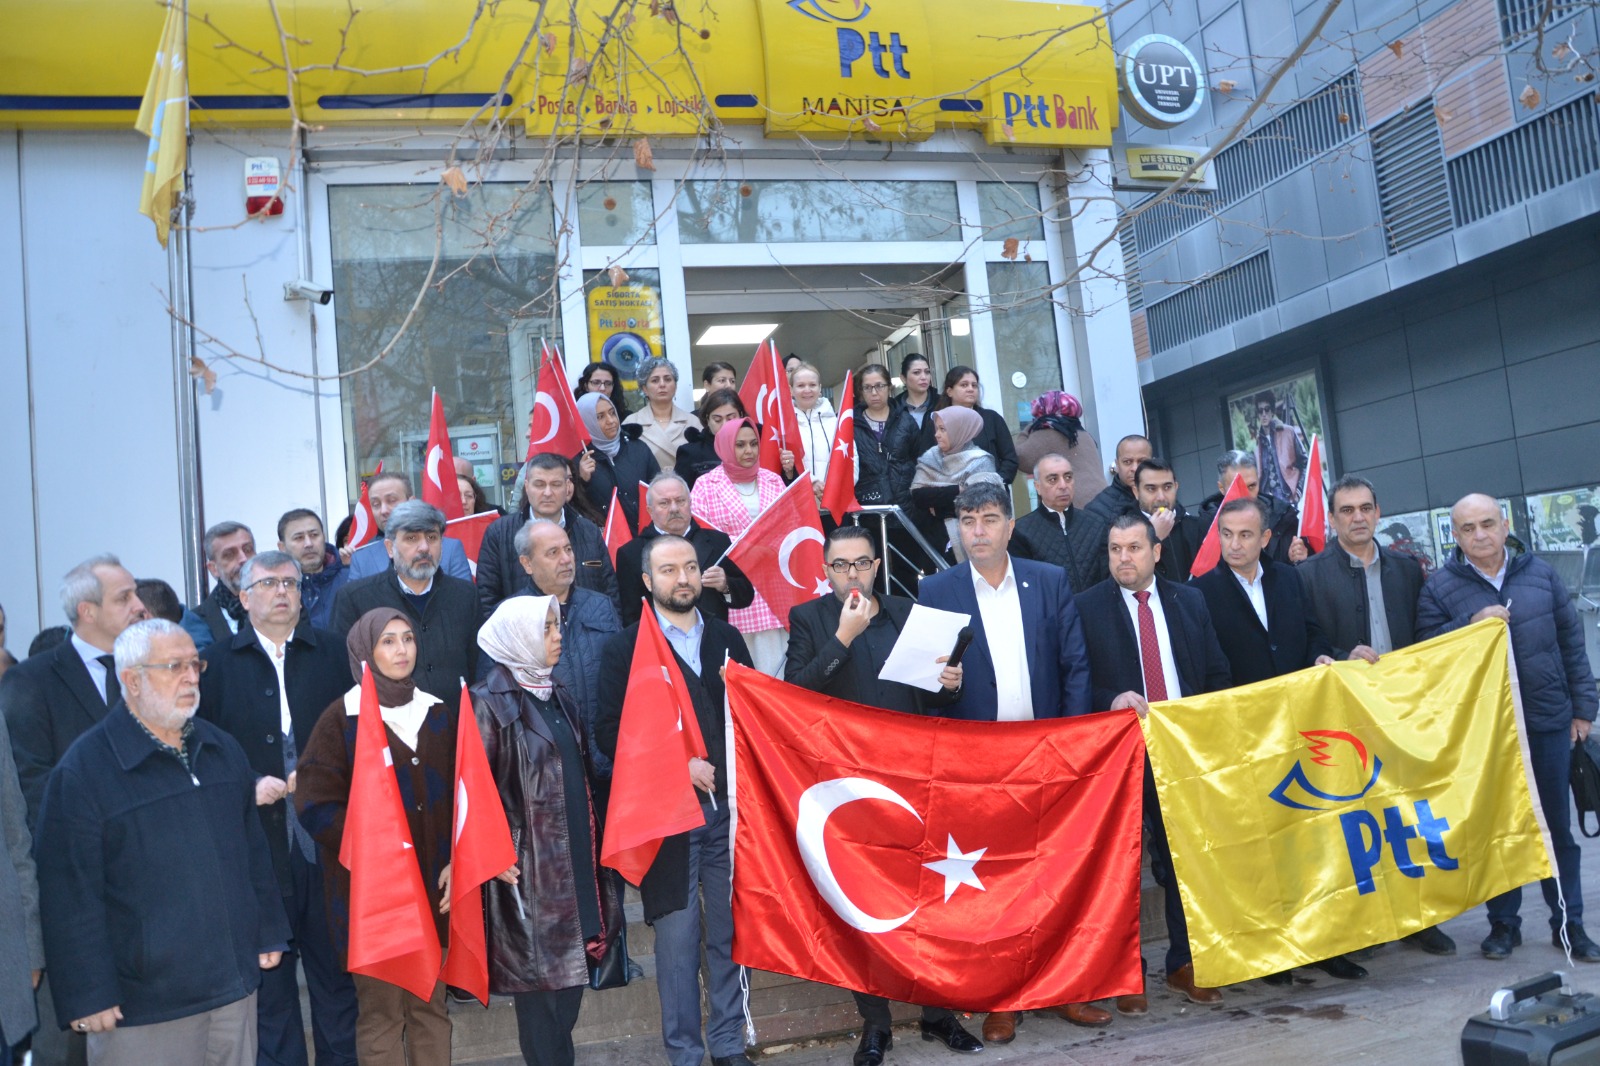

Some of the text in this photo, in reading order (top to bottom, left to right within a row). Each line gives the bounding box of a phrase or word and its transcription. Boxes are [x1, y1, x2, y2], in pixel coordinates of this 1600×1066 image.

[836, 27, 911, 79] Ptt
[1138, 63, 1192, 87] UPT
[538, 95, 702, 117] Posta Banka Lojistik
[802, 95, 906, 117] MANİSA
[1140, 155, 1188, 165] WESTERN
[1157, 163, 1189, 172] UNION
[1338, 798, 1459, 896] Ptt
